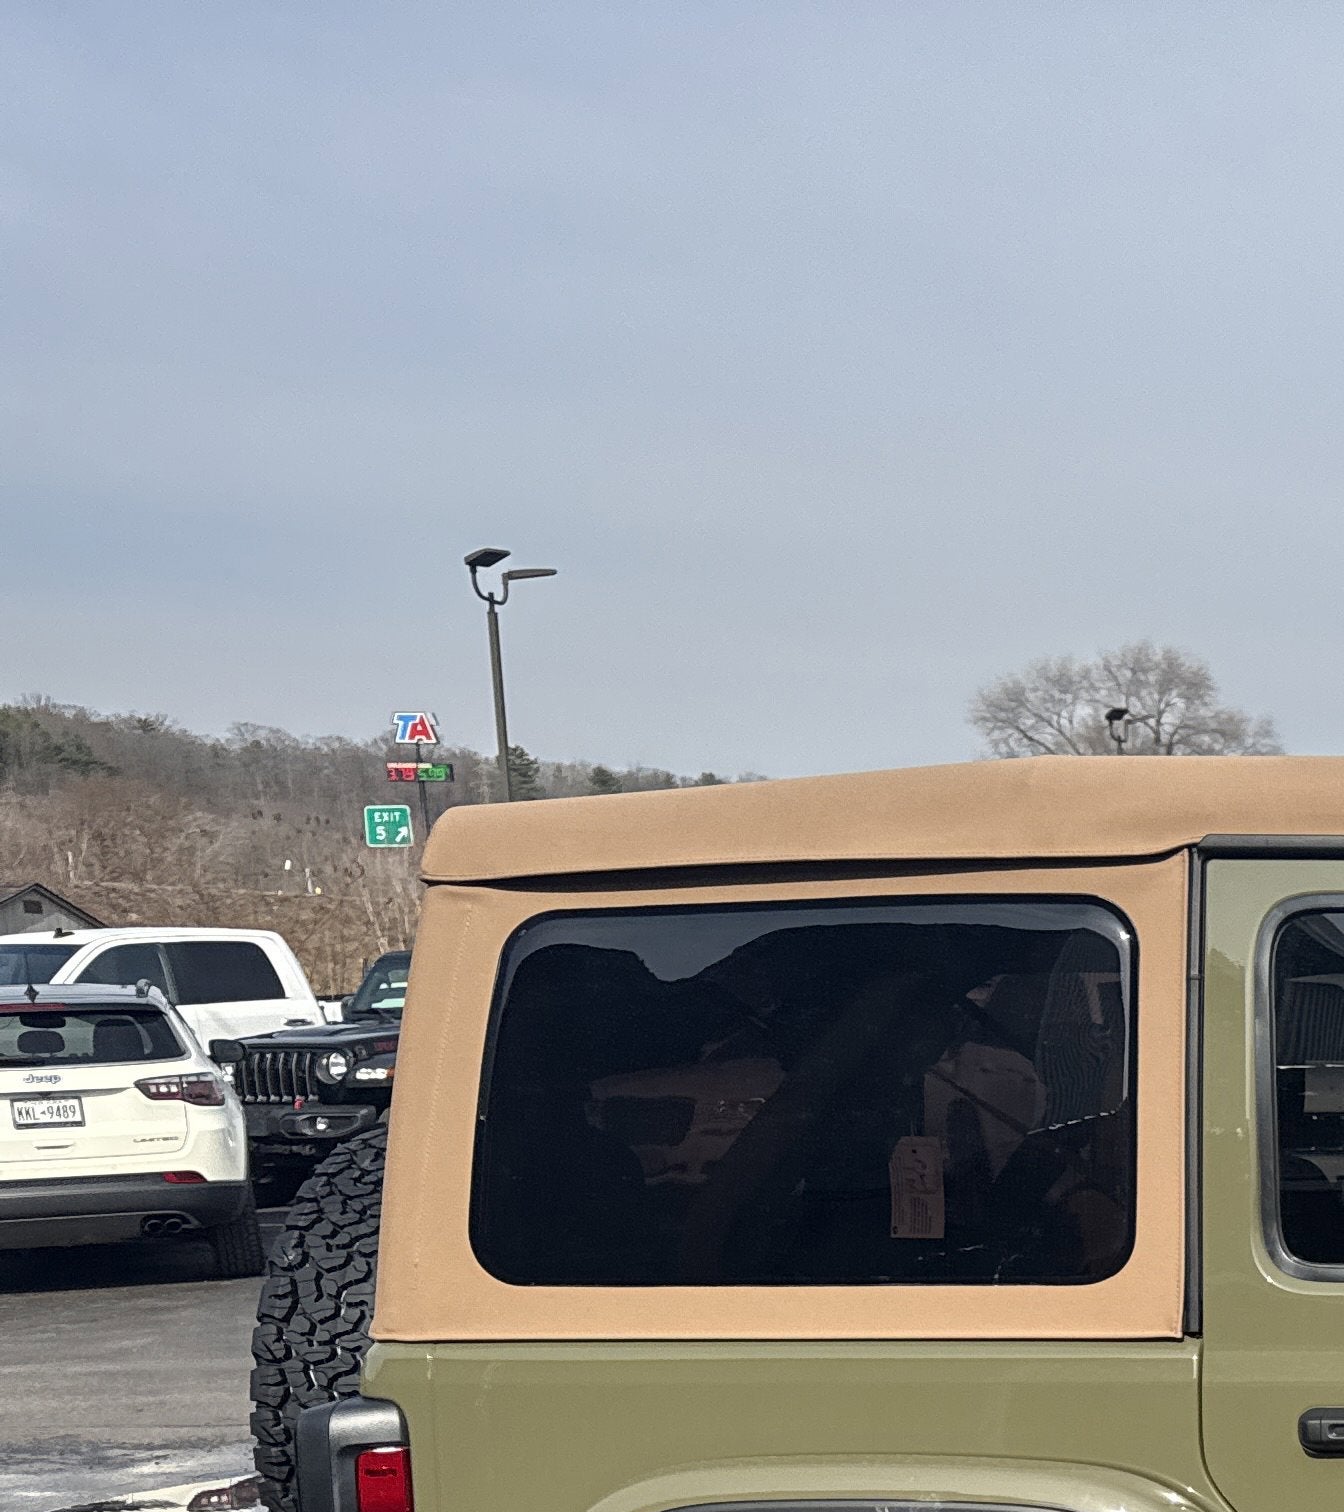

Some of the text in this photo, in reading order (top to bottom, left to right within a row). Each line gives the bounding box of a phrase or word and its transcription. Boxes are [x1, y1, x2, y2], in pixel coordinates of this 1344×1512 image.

[394, 713, 437, 743] TA
[373, 811, 402, 823] EXIT
[375, 825, 387, 841] 5
